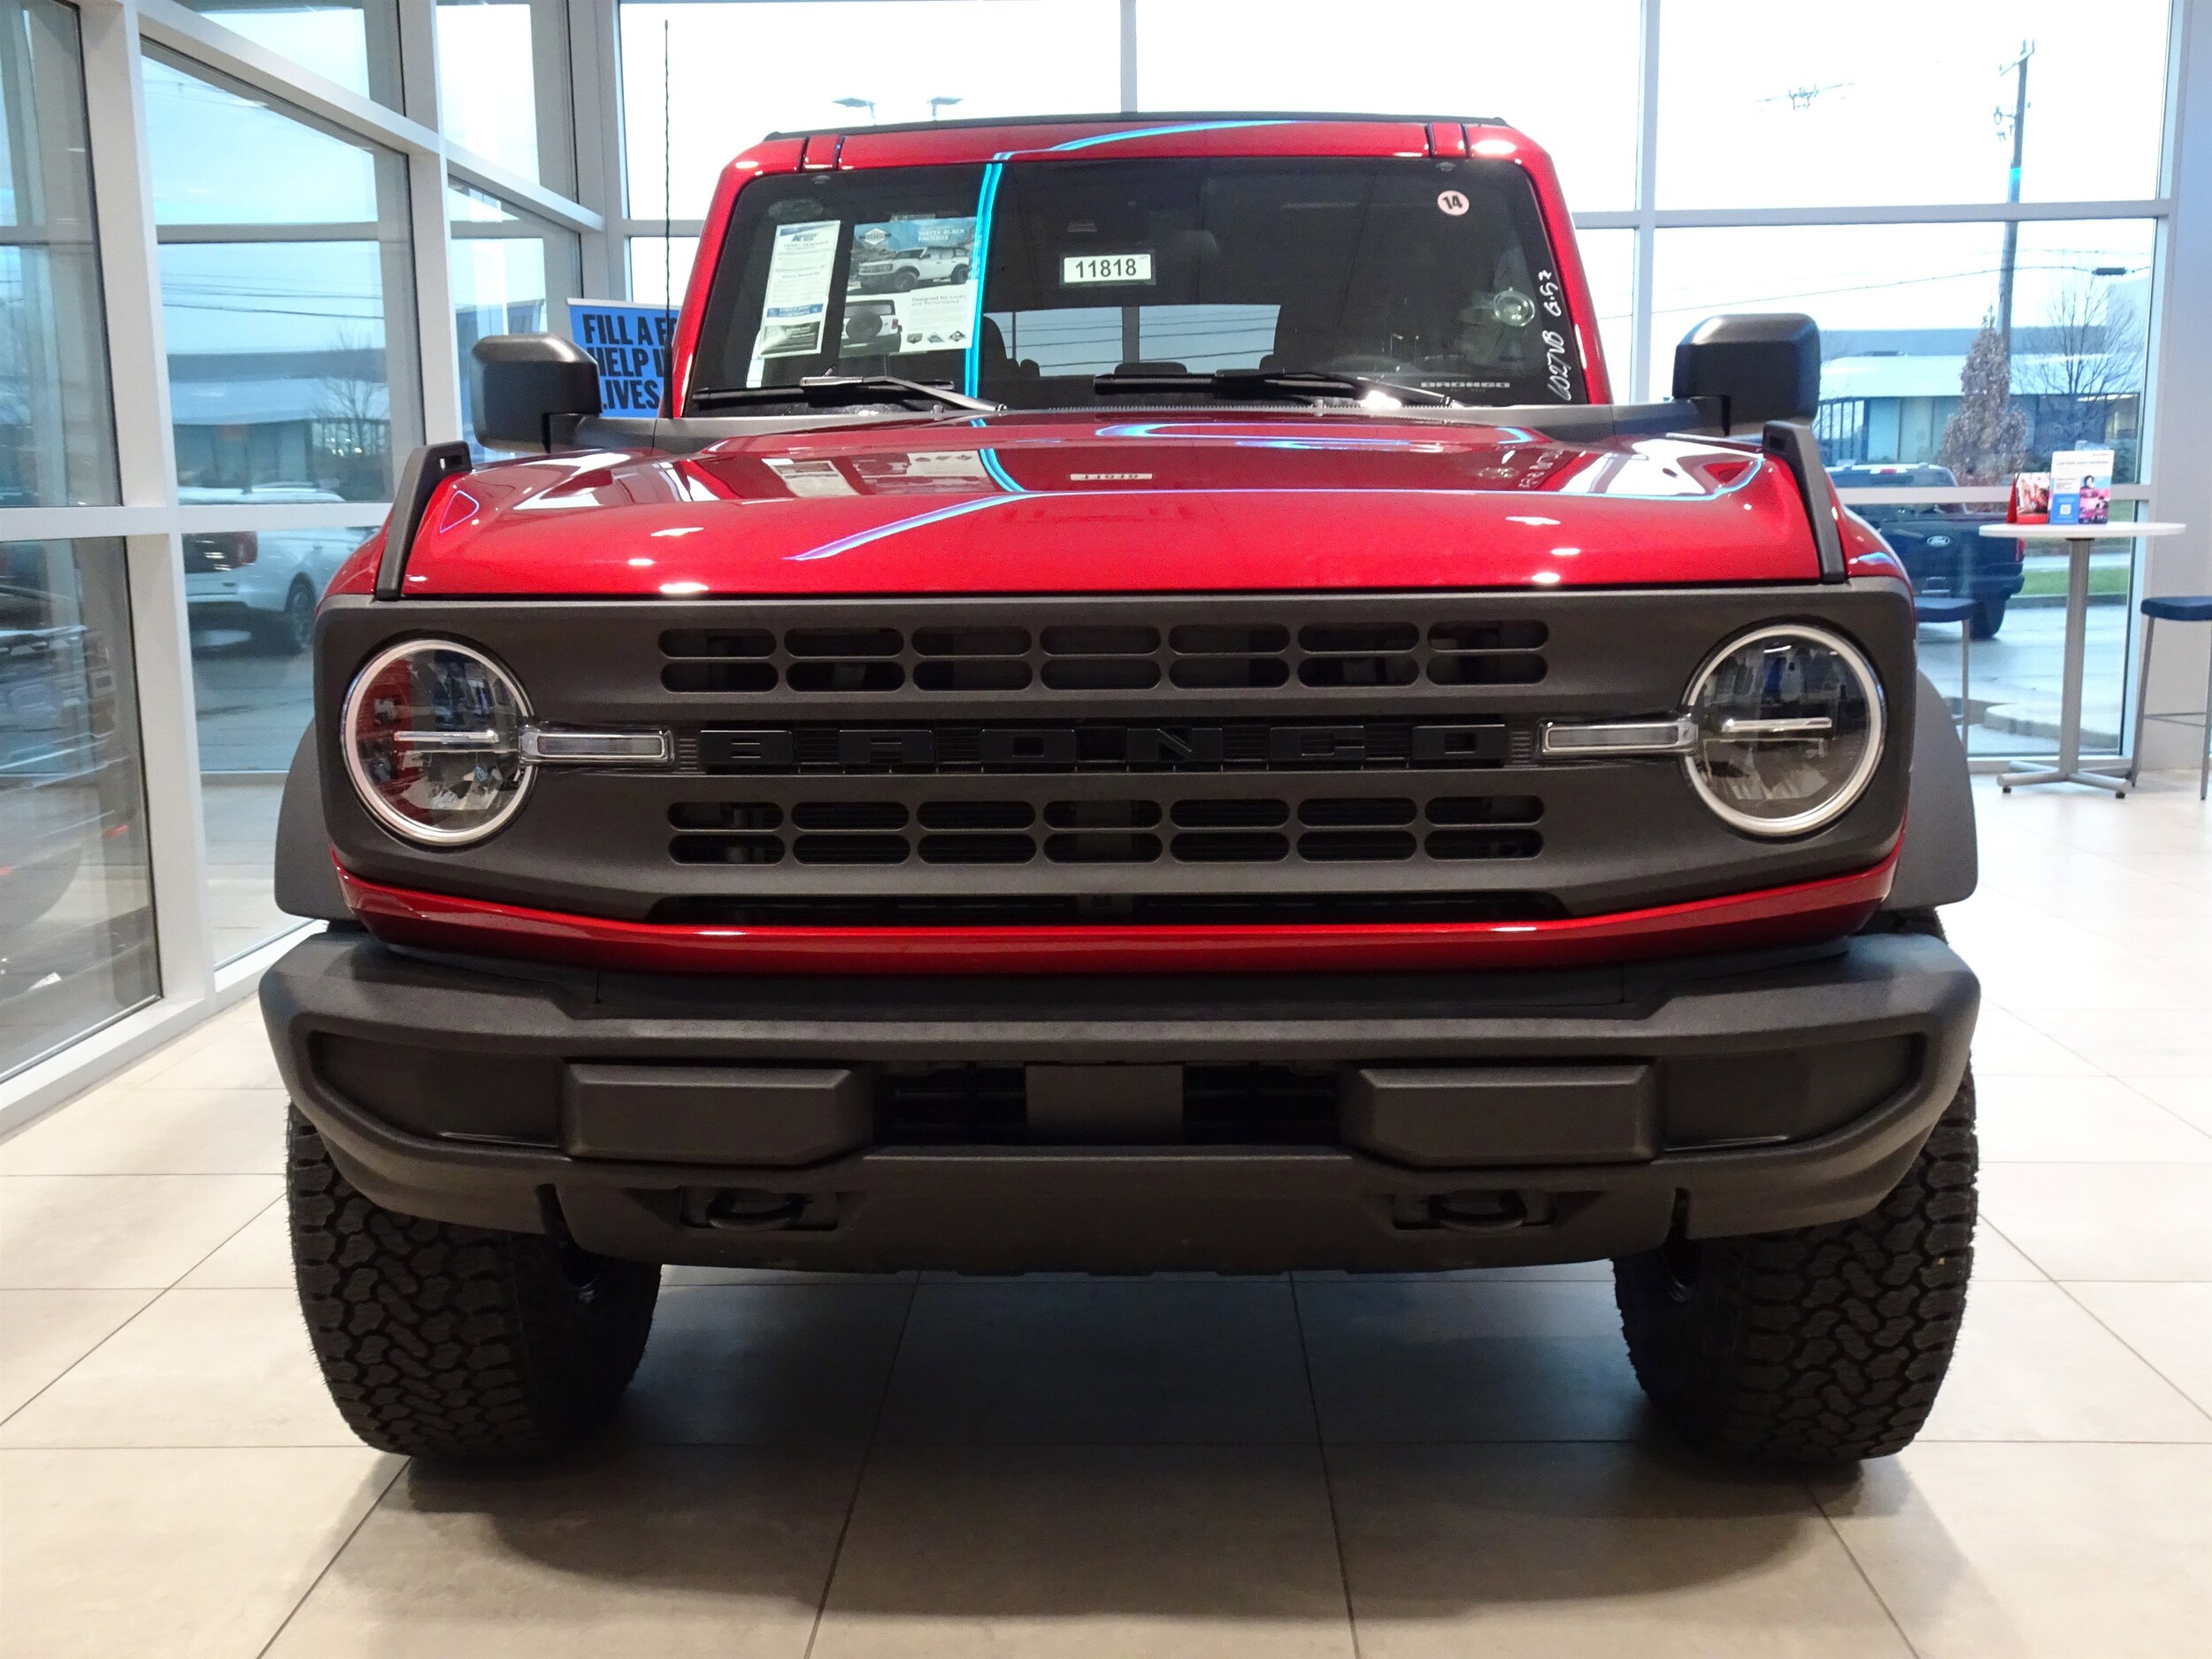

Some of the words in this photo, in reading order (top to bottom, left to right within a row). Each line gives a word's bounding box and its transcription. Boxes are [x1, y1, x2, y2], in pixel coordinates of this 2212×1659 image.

[1442, 195, 1463, 210] 14
[1075, 257, 1137, 279] 11818
[582, 313, 634, 345] FILL
[637, 316, 654, 346] A
[587, 347, 649, 378] HELP
[603, 380, 660, 410] IVES
[699, 724, 1506, 765] BRONCO
